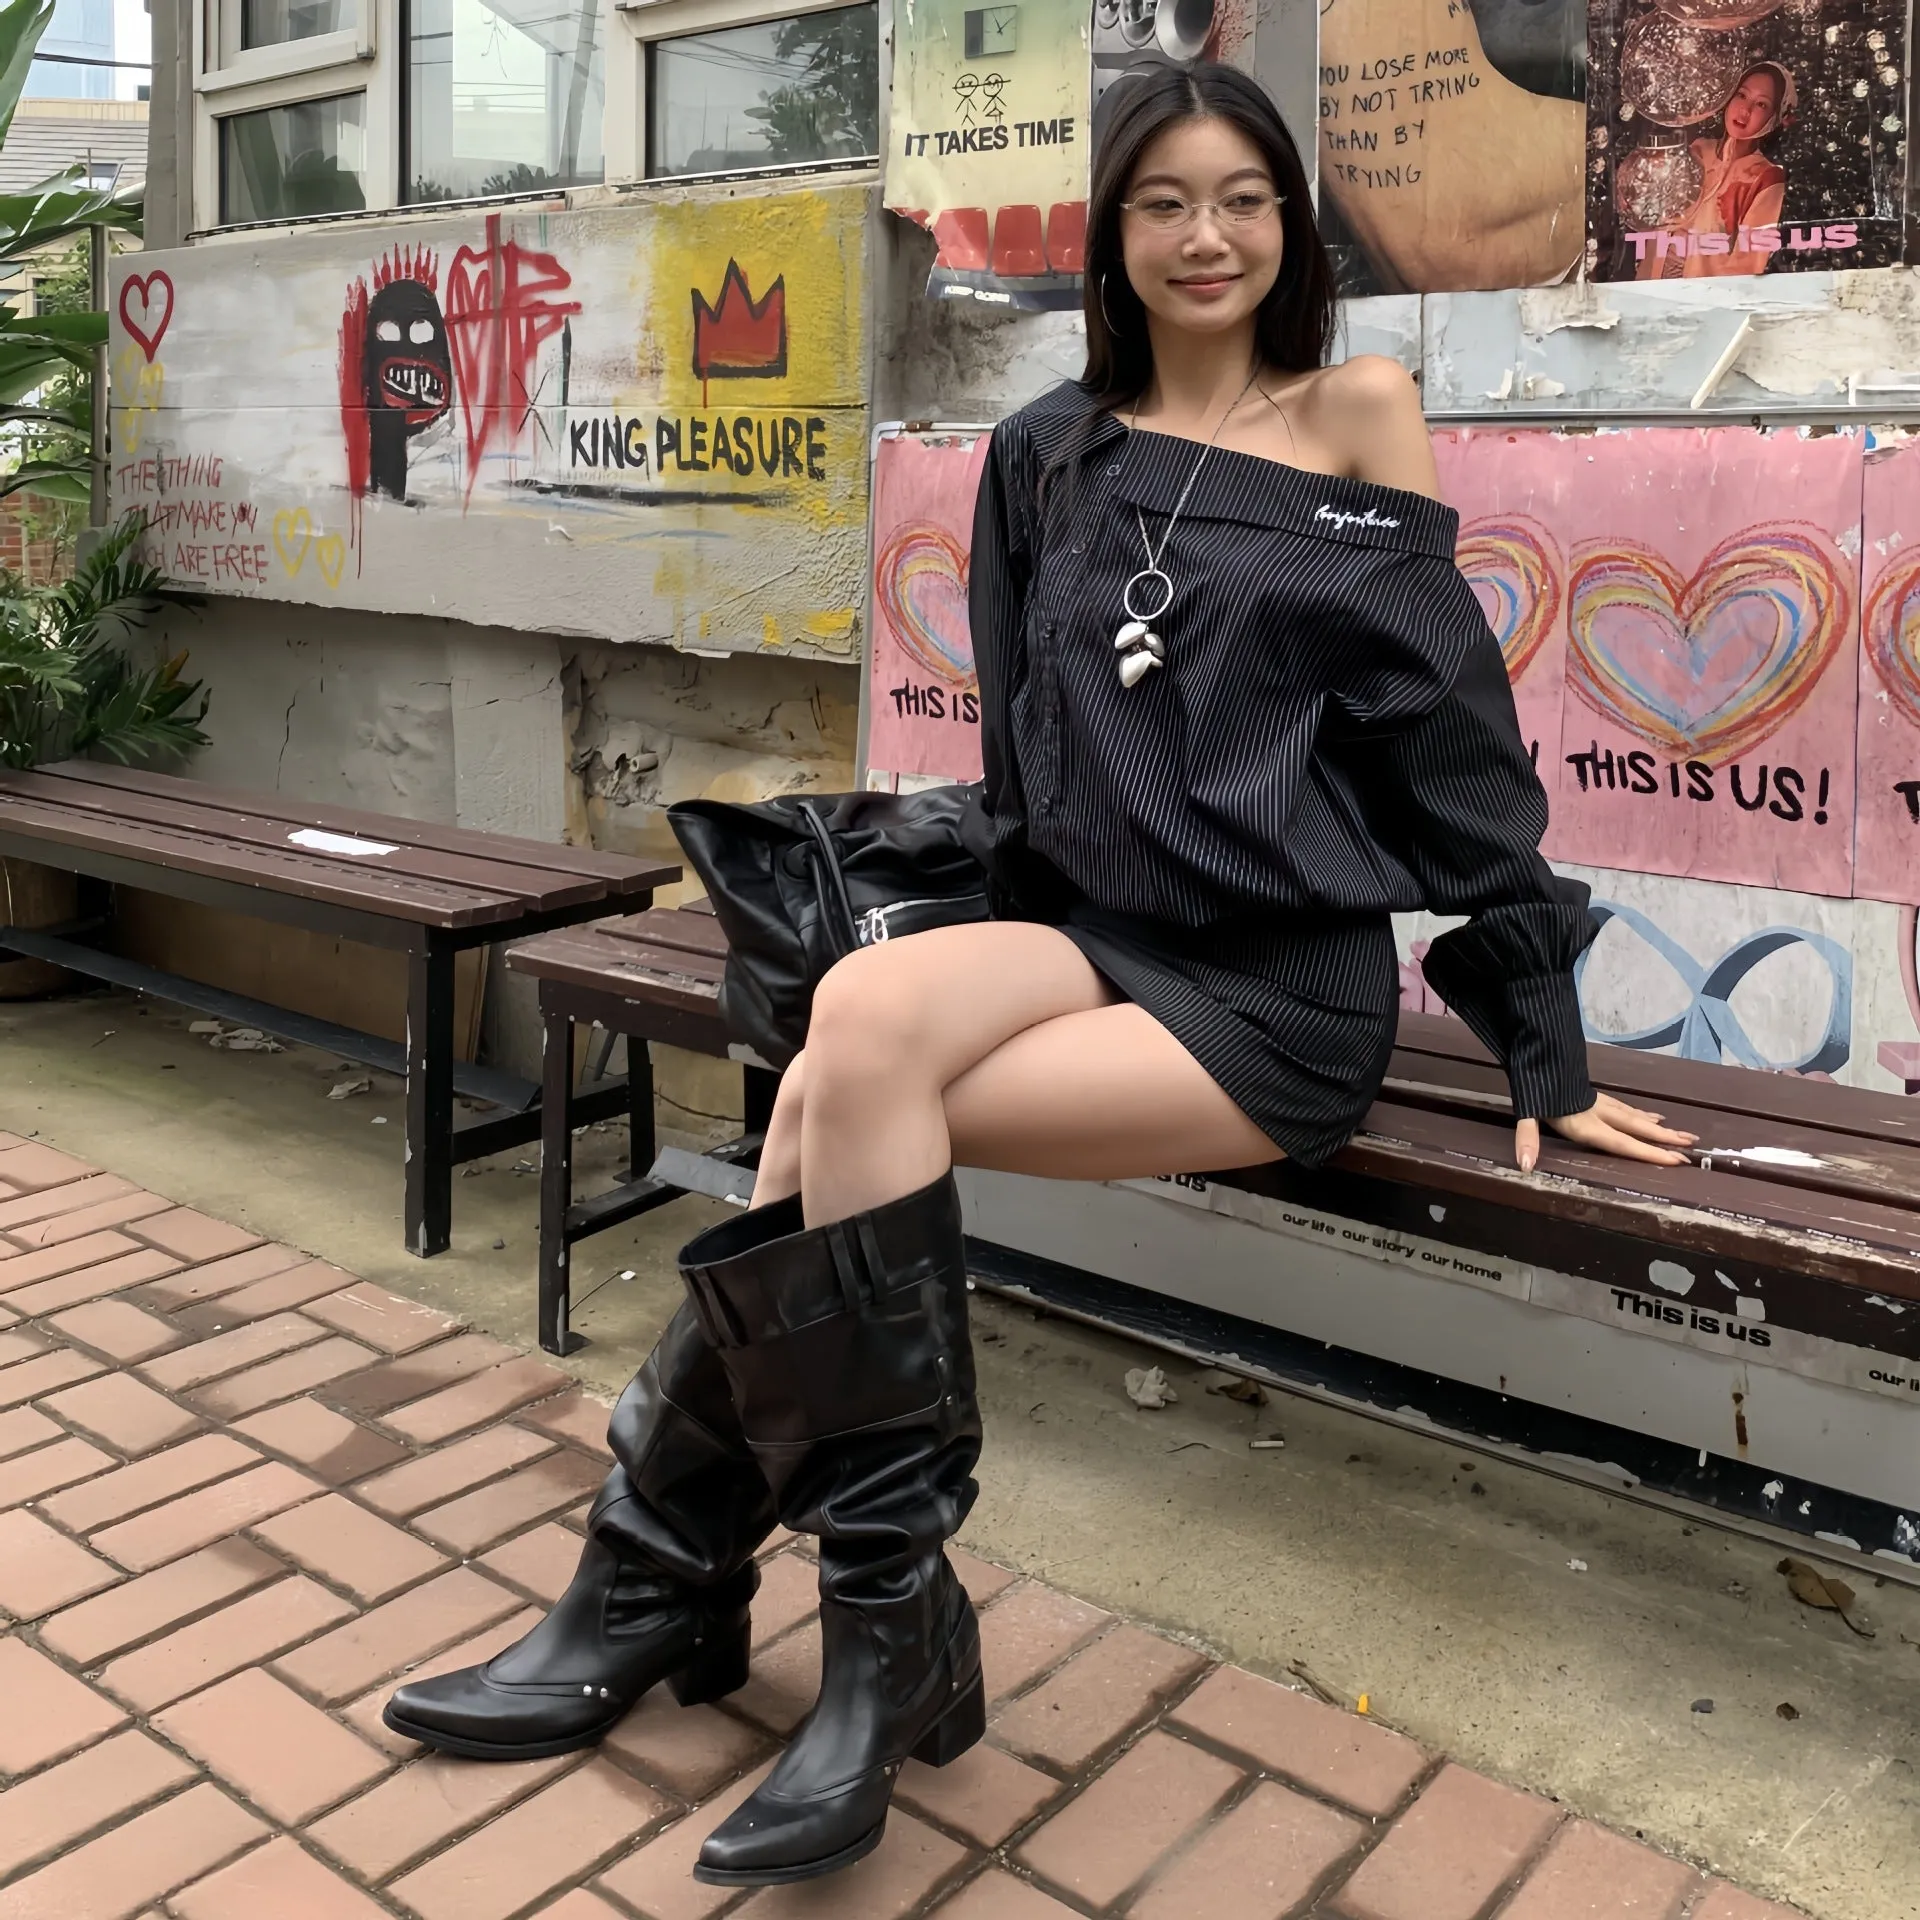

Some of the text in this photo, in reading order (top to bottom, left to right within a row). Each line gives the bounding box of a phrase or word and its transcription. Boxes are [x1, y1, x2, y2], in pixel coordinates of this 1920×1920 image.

[1361, 54, 1415, 81] LOSE
[1425, 48, 1469, 69] MORE
[1319, 72, 1480, 118] BY NOT TRYING
[905, 117, 1074, 156] IT TAKES TIME
[1325, 119, 1424, 151] THAN BY
[1334, 164, 1421, 188] TRYING
[1624, 224, 1859, 260] This is us
[571, 415, 828, 482] KING PLEASURE
[116, 451, 224, 494] THE THING
[177, 500, 226, 539] MAKE
[173, 542, 209, 576] ARE
[889, 677, 979, 723] THIS IS
[1565, 740, 1659, 793] THIS
[1670, 760, 1714, 801] IS
[1282, 1212, 1502, 1282] our life our story our home
[1610, 1287, 1771, 1348] This is us
[1869, 1369, 1906, 1386] our
